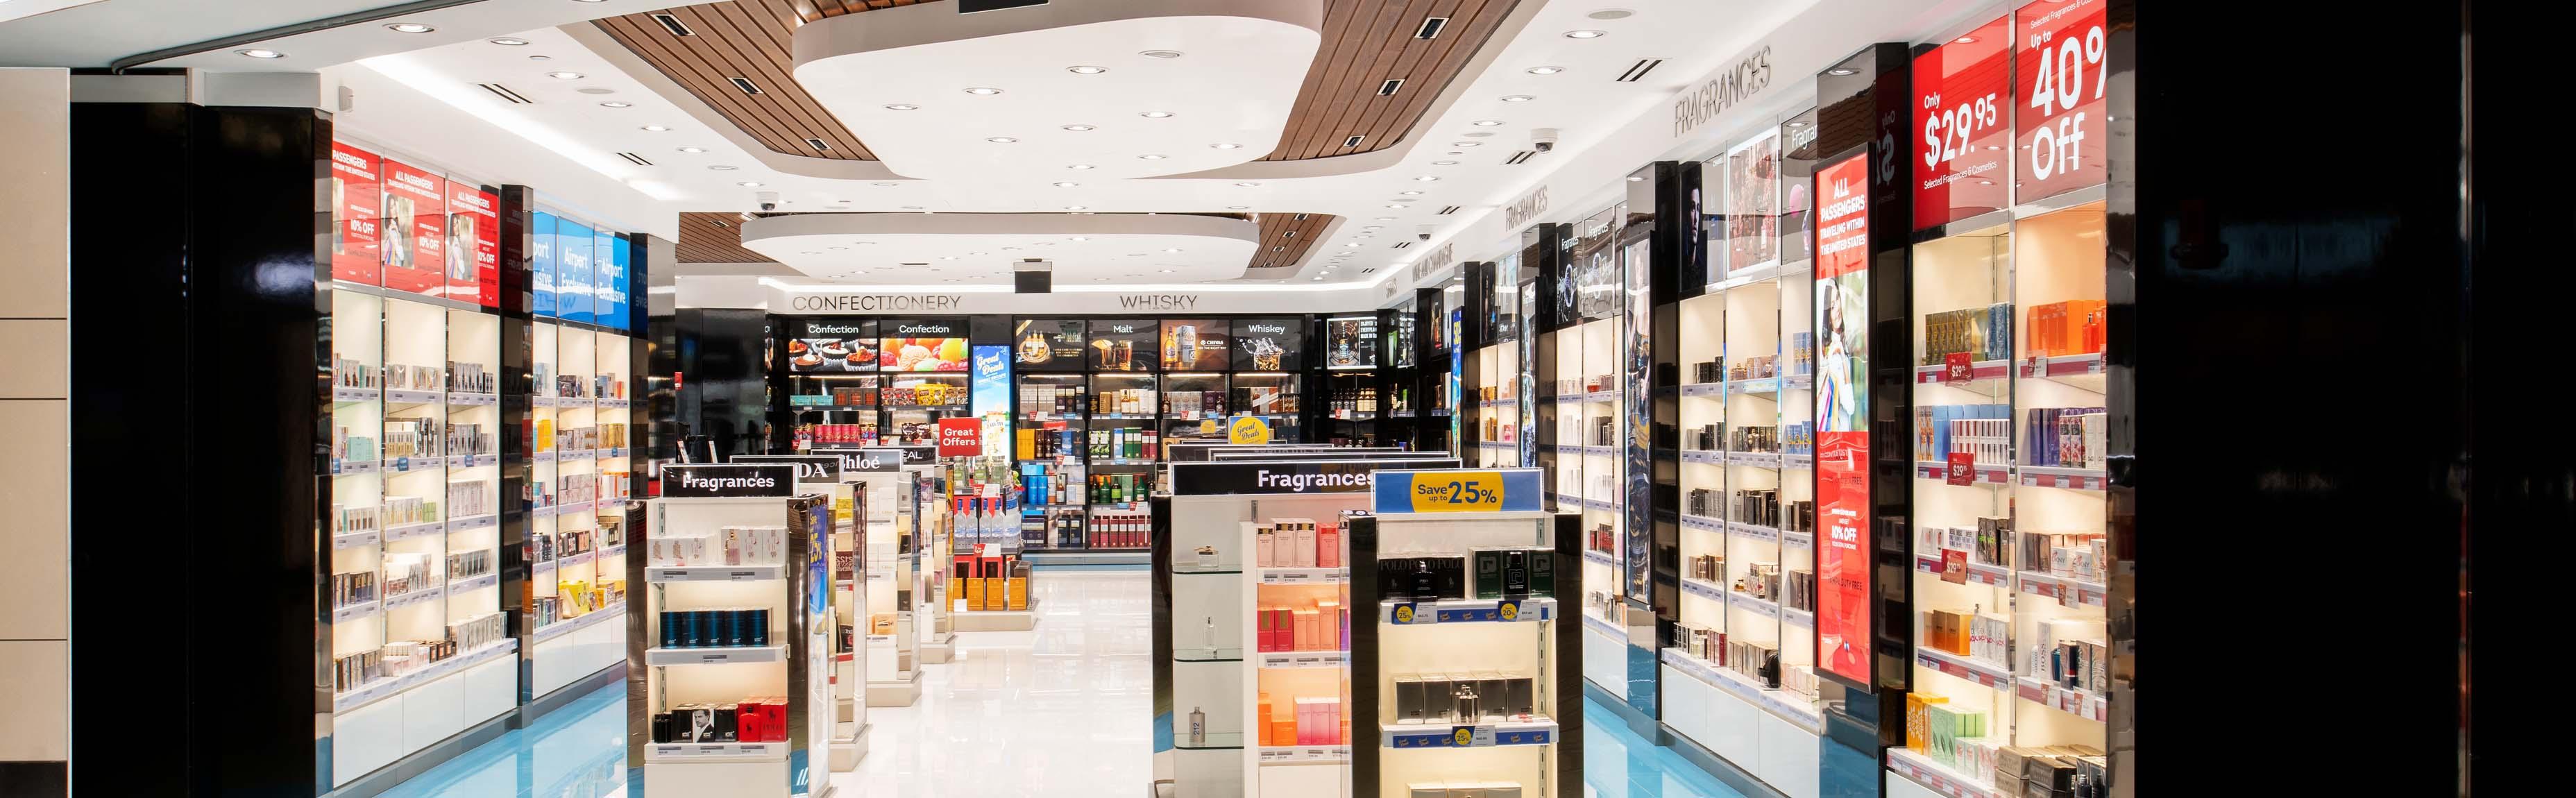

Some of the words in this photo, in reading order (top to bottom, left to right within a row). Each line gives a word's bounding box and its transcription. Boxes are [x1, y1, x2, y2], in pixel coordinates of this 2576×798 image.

[2031, 15, 2050, 28] Selected
[2051, 3, 2076, 19] Fragrances
[2031, 33, 2042, 51] Up
[2042, 30, 2051, 43] to
[1675, 45, 1770, 137] FRAGRANCES
[1924, 92, 1940, 109] Only
[2031, 112, 2085, 180] Off
[333, 150, 366, 169] PASSENGERS
[395, 171, 404, 181] ALL
[404, 173, 433, 191] PASSENGERS
[1924, 175, 1942, 189] Selected
[1943, 168, 1967, 185] Fragrances
[1967, 167, 1972, 176] &
[1972, 160, 1997, 175] Cosmetics
[1833, 178, 1849, 200] ALL
[1506, 185, 1548, 232] FRAGRANCES
[1821, 194, 1865, 222] PASSENGERS
[350, 219, 362, 232] 10%
[362, 222, 374, 235] OFF
[1588, 222, 1609, 241] Fragrances
[1821, 222, 1846, 239] TRAVELING
[1846, 217, 1865, 231] WITHIN
[430, 238, 439, 250] OFF
[1561, 236, 1579, 253] Fragrances
[1821, 244, 1829, 256] THE
[1847, 233, 1865, 249] STATES
[486, 253, 495, 264] OFF
[564, 246, 588, 272] Airport
[601, 257, 623, 282] Airport
[561, 273, 591, 296] Exclusive
[599, 282, 626, 304] Exclusive
[793, 295, 961, 311] CONFECTIONERY
[1120, 295, 1197, 309] WHISKY
[808, 325, 858, 334] Confection
[899, 325, 949, 334] Confection
[1113, 325, 1133, 333] Malt
[1248, 324, 1285, 334] Whiskey
[977, 352, 999, 371] Great
[982, 361, 1004, 375] Deals
[944, 427, 974, 436] Great
[1237, 422, 1255, 436] Great
[1242, 430, 1260, 439] Deals
[942, 437, 976, 446] Offers
[683, 475, 774, 491] Fragrances
[1418, 484, 1448, 495] Save
[1429, 495, 1439, 503] up
[1448, 482, 1497, 504] 25%
[1832, 525, 1843, 540] 10%
[1844, 527, 1856, 542] OFF
[1381, 560, 1407, 570] POLO
